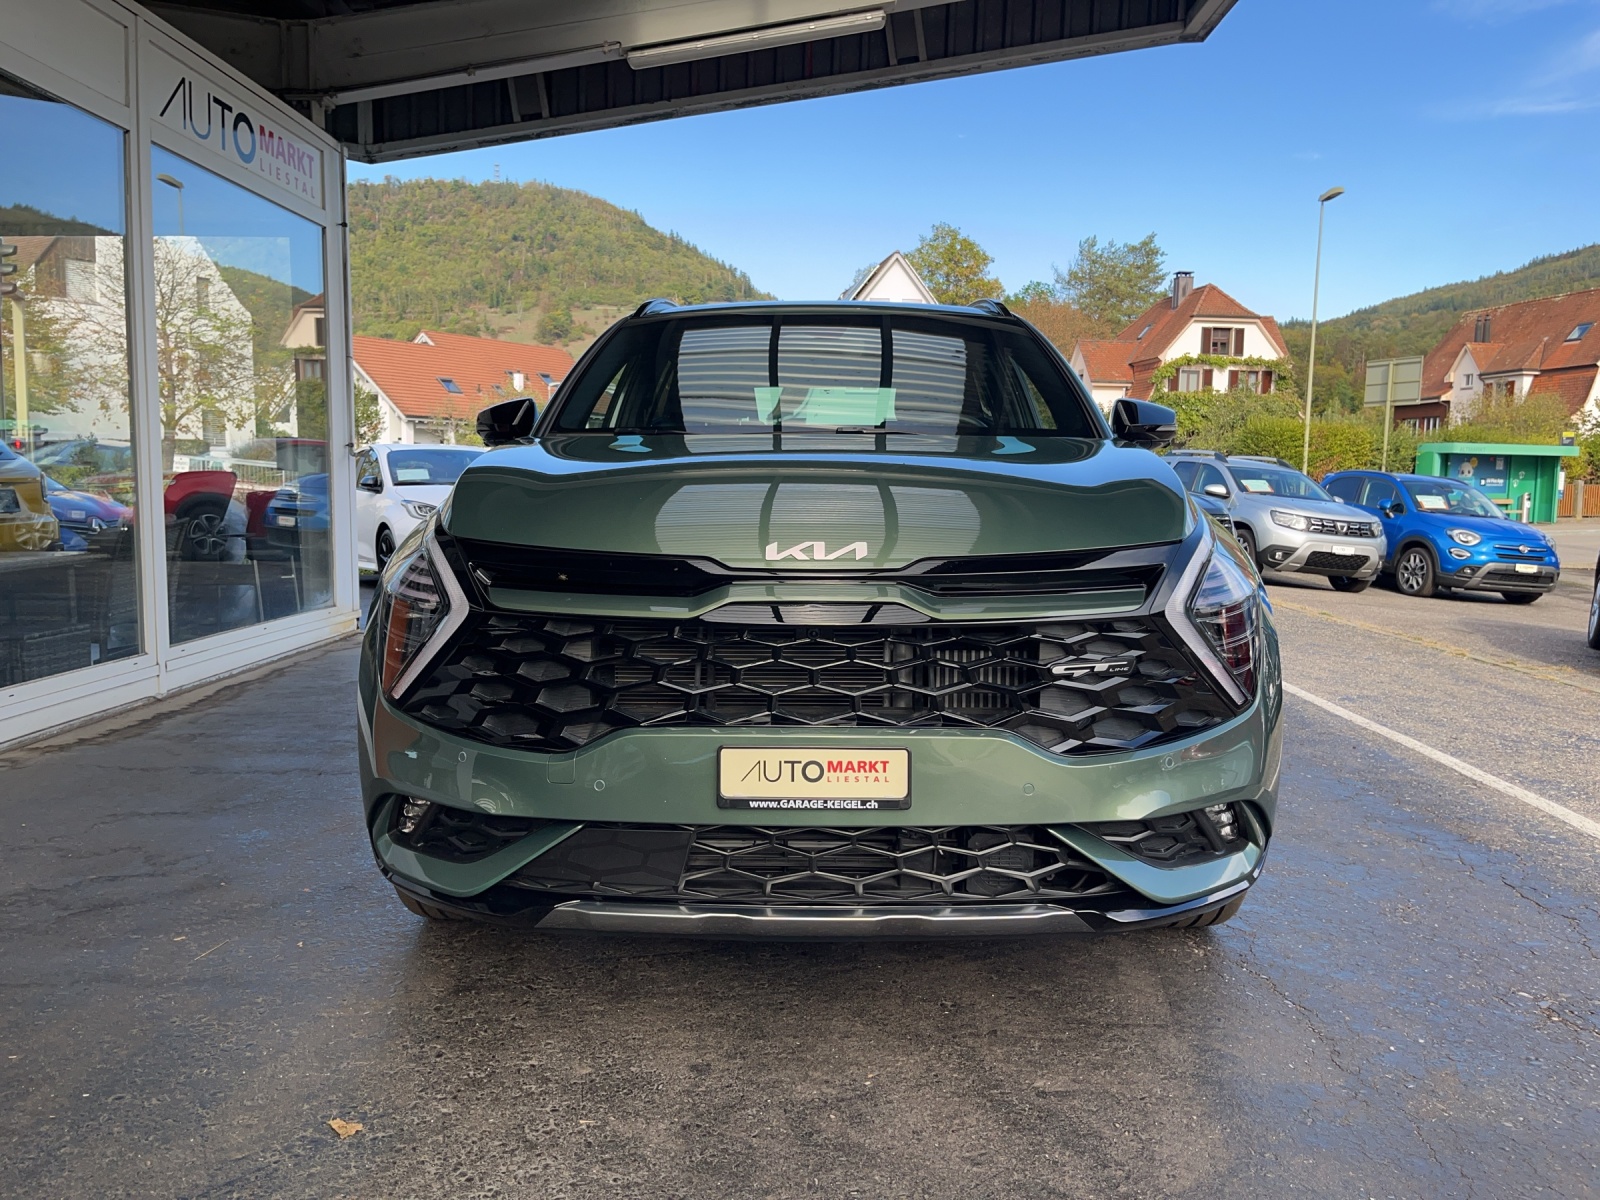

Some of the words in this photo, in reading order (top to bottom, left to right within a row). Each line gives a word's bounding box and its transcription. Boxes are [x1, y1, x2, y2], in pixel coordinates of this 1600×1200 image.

[159, 77, 257, 164] AUTO
[259, 124, 315, 179] MARKT
[259, 158, 316, 199] LIESTAL
[765, 541, 868, 561] KIA
[741, 760, 825, 783] AUTO
[827, 760, 889, 773] MARKT
[749, 800, 878, 809] www.GARAGE-KEIGEL.ch
